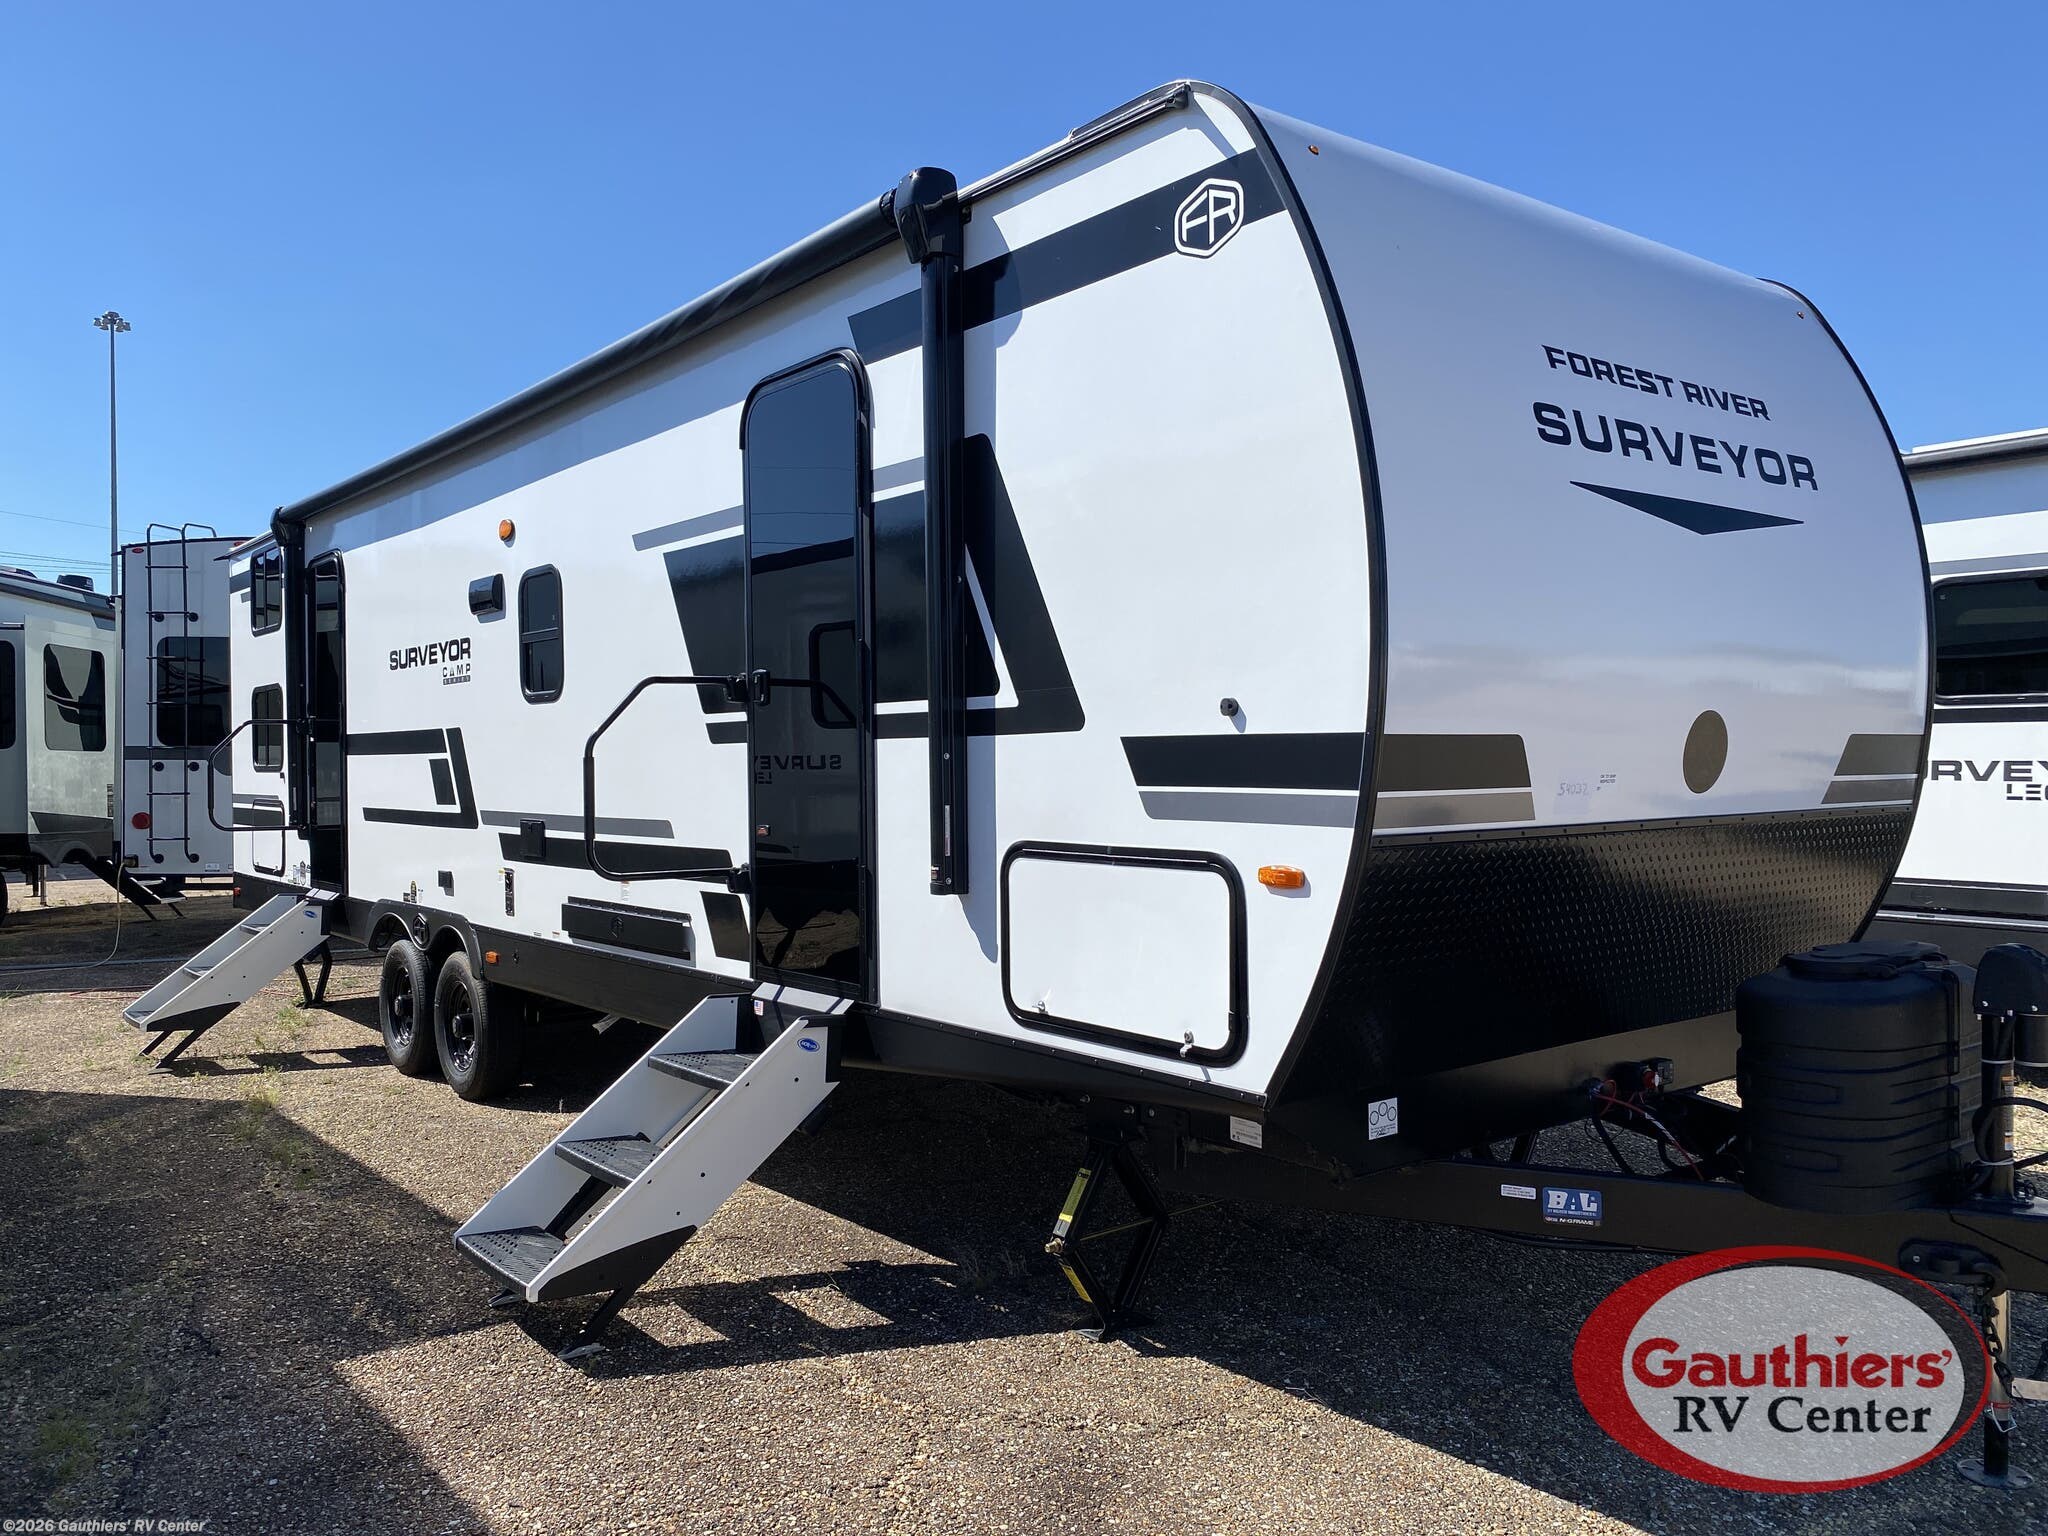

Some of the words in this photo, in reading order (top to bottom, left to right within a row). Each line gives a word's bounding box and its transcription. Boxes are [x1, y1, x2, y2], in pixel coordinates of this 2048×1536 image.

[1181, 188, 1237, 245] FR
[1541, 344, 1675, 398] FOREST
[1679, 379, 1771, 421] RIVER
[1532, 401, 1818, 491] SURVEYOR
[389, 636, 472, 671] SURVEYOR
[442, 662, 471, 678] CAMP
[1926, 760, 2048, 782] RVE
[2006, 783, 2048, 801] LE
[1547, 1190, 1598, 1212] BAL
